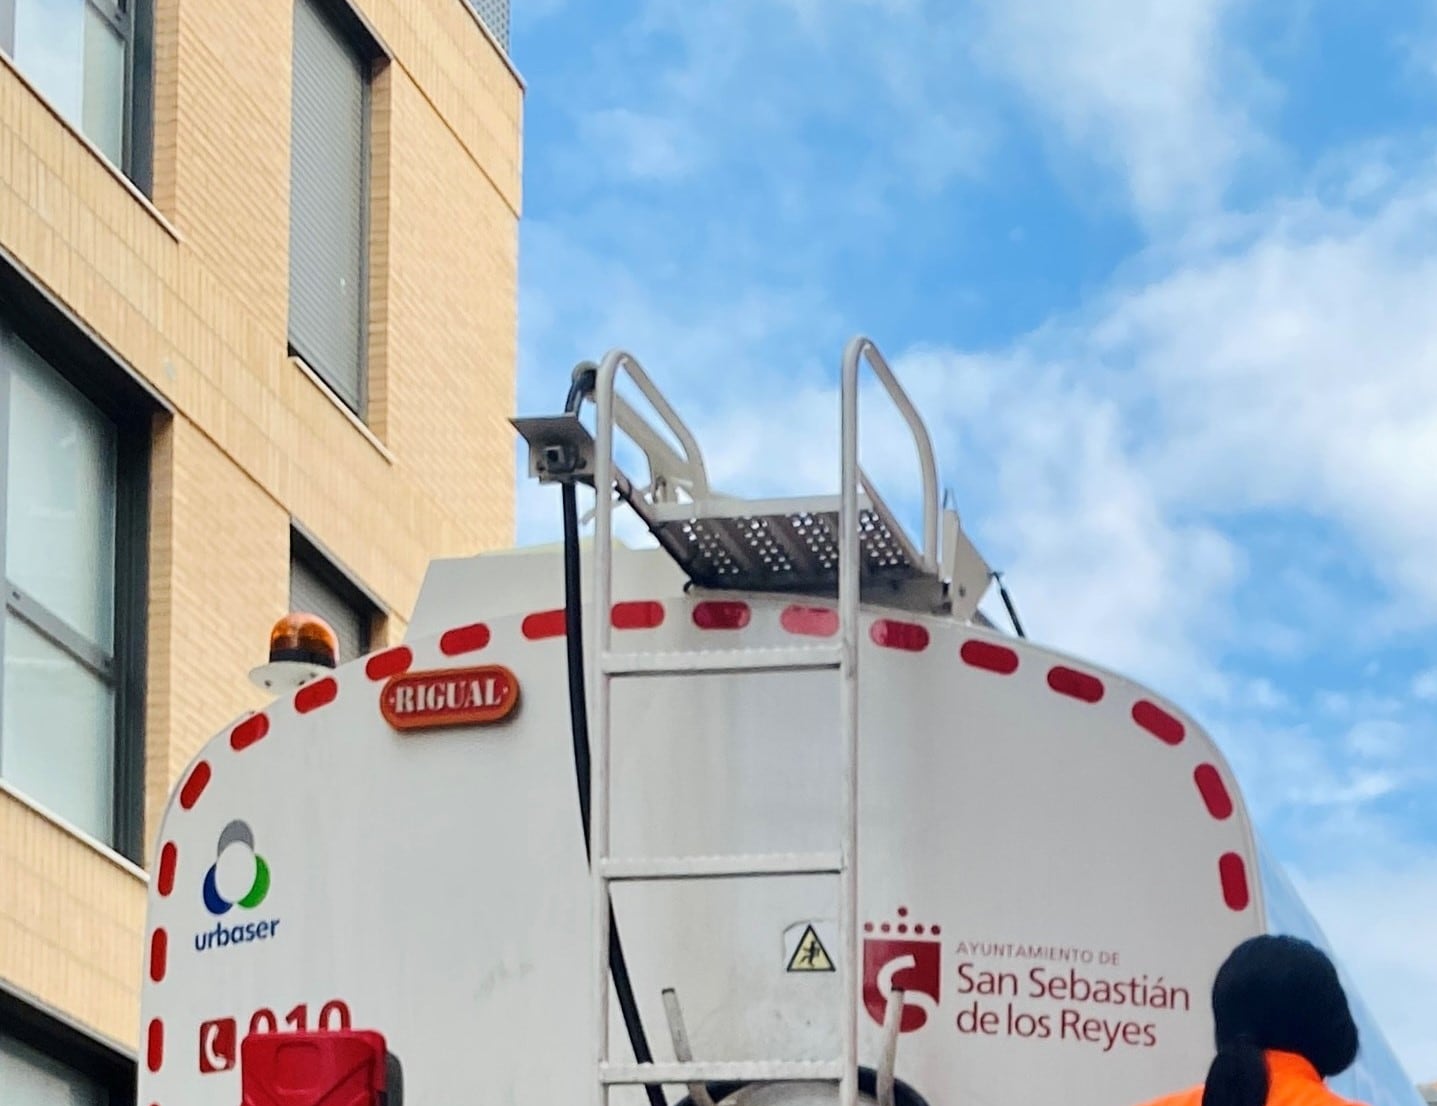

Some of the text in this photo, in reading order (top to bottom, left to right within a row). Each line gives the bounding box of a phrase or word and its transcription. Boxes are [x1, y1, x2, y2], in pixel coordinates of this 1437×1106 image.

[395, 679, 502, 713] RIGUAL
[194, 919, 280, 951] urbaser
[956, 941, 1121, 967] AYUNTAMIENTO DE
[957, 963, 1191, 1012] San Sebastián
[956, 1001, 1157, 1052] de los Reyes
